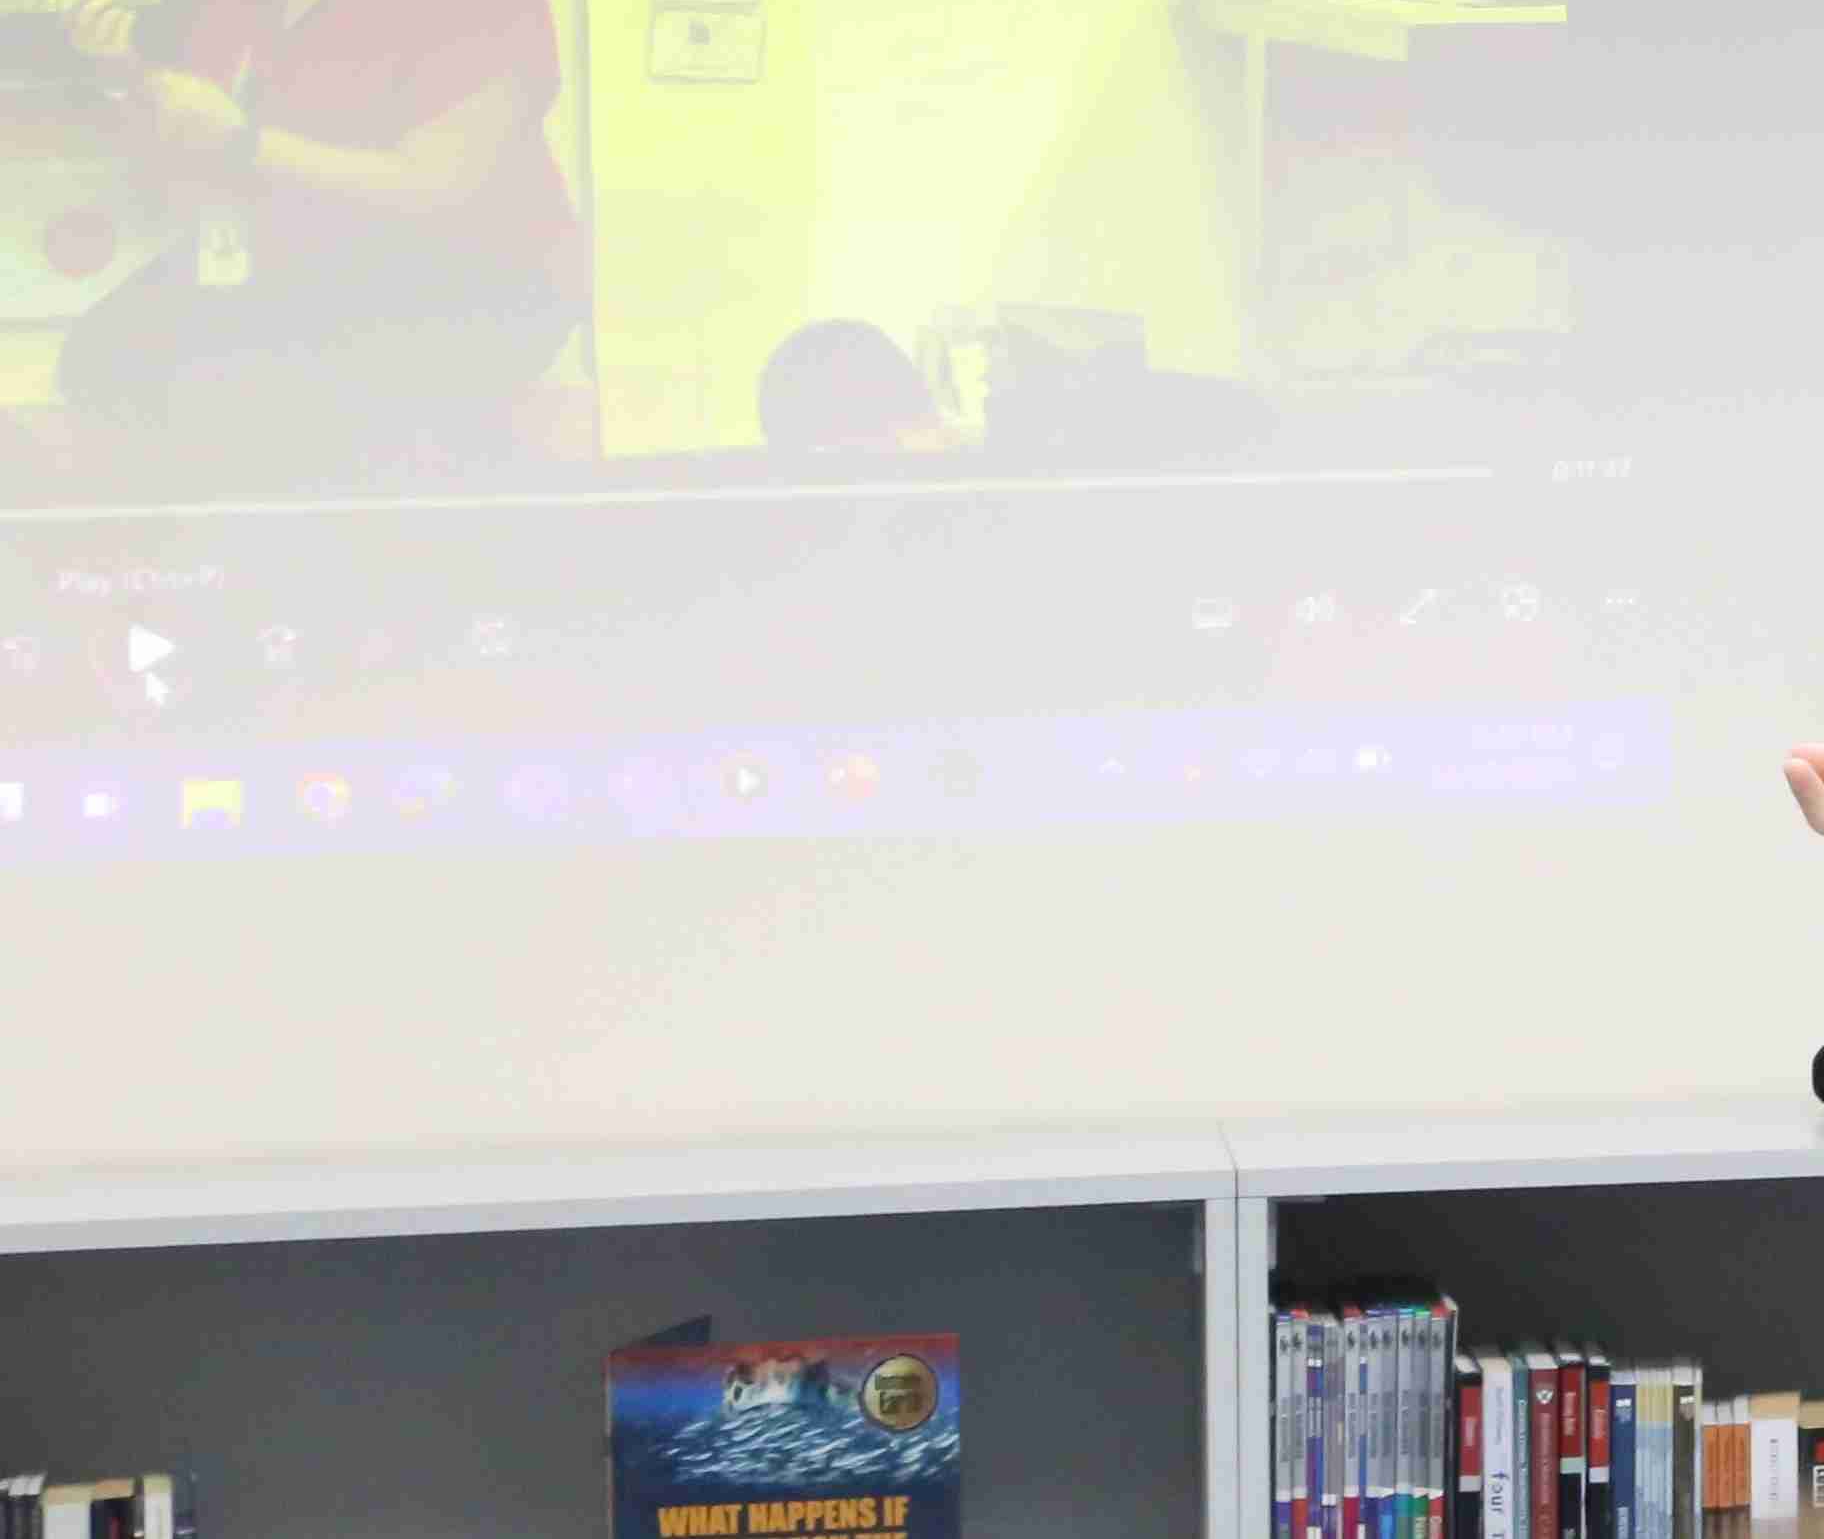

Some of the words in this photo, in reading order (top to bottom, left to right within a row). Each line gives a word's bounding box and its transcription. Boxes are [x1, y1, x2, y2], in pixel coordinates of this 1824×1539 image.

[658, 1503, 742, 1538] WHAT
[747, 1497, 877, 1533] HAPPENS
[883, 1495, 910, 1527] IF
